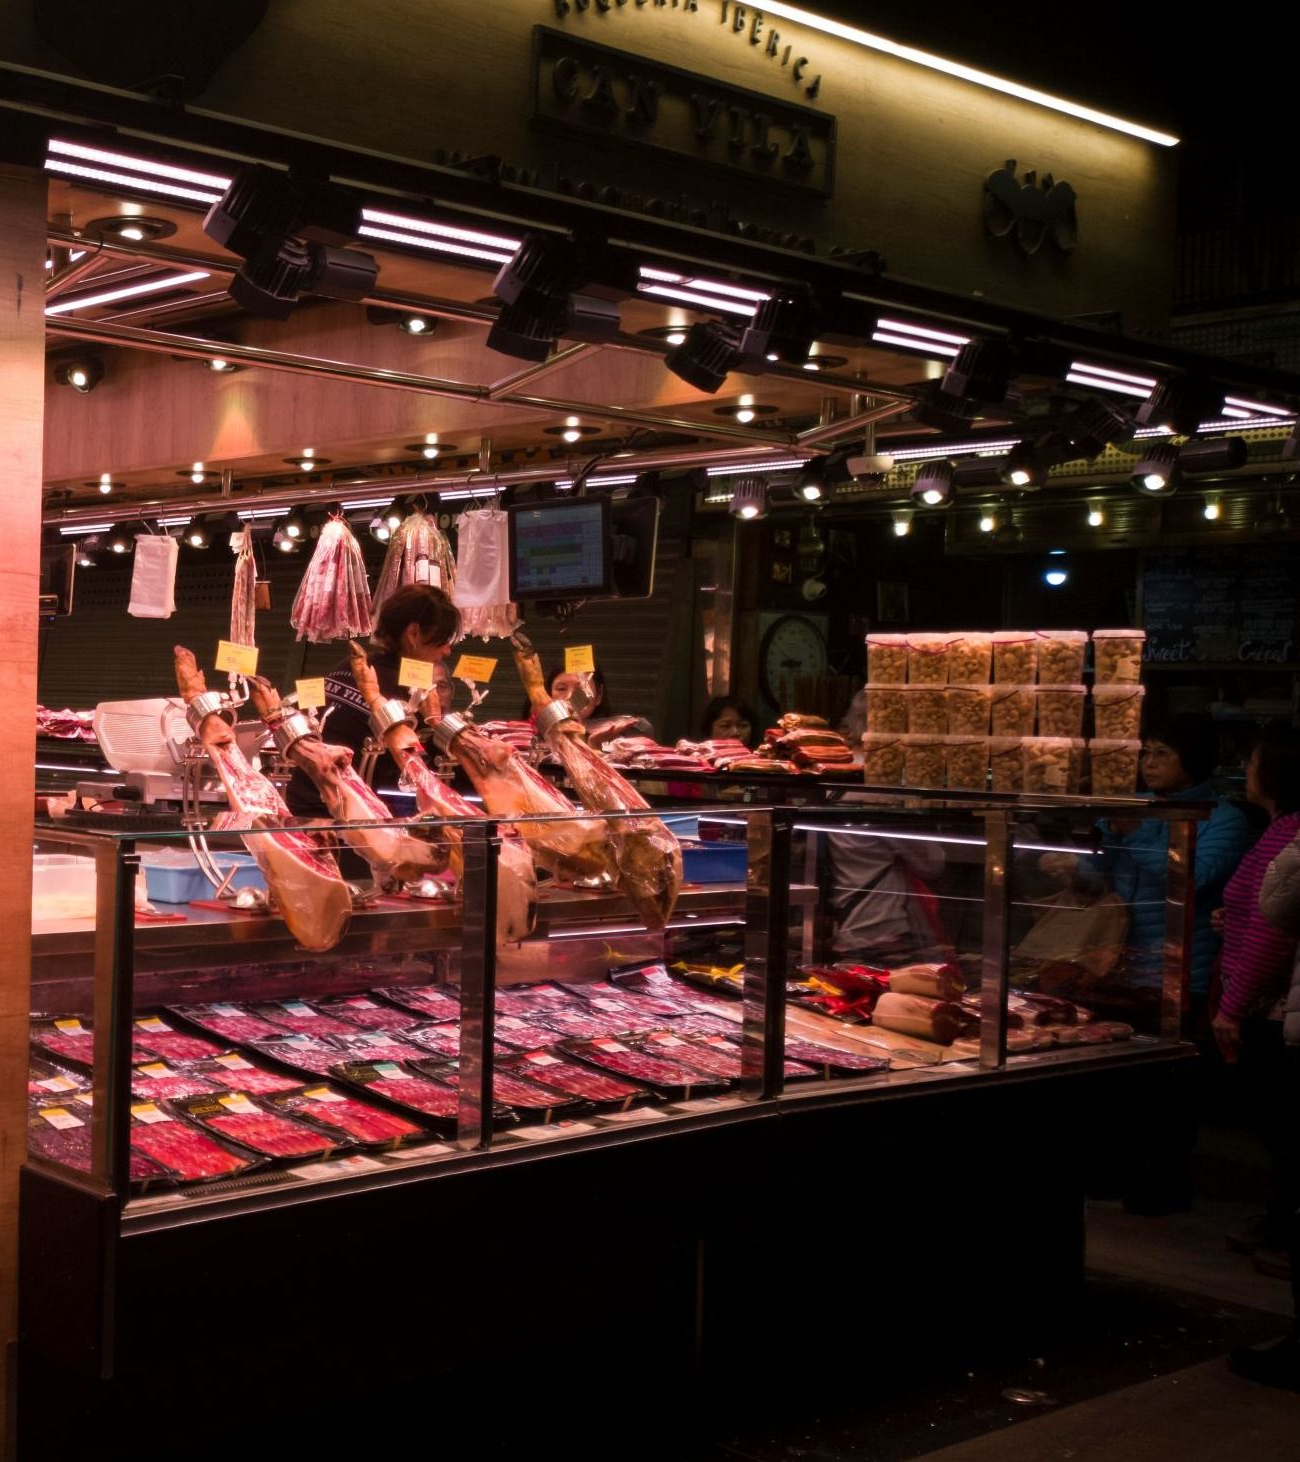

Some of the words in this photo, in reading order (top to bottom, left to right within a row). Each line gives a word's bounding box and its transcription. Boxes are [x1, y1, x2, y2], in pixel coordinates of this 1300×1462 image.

[553, 56, 662, 124] CAN
[692, 93, 813, 168] VILA
[325, 680, 341, 694] AN
